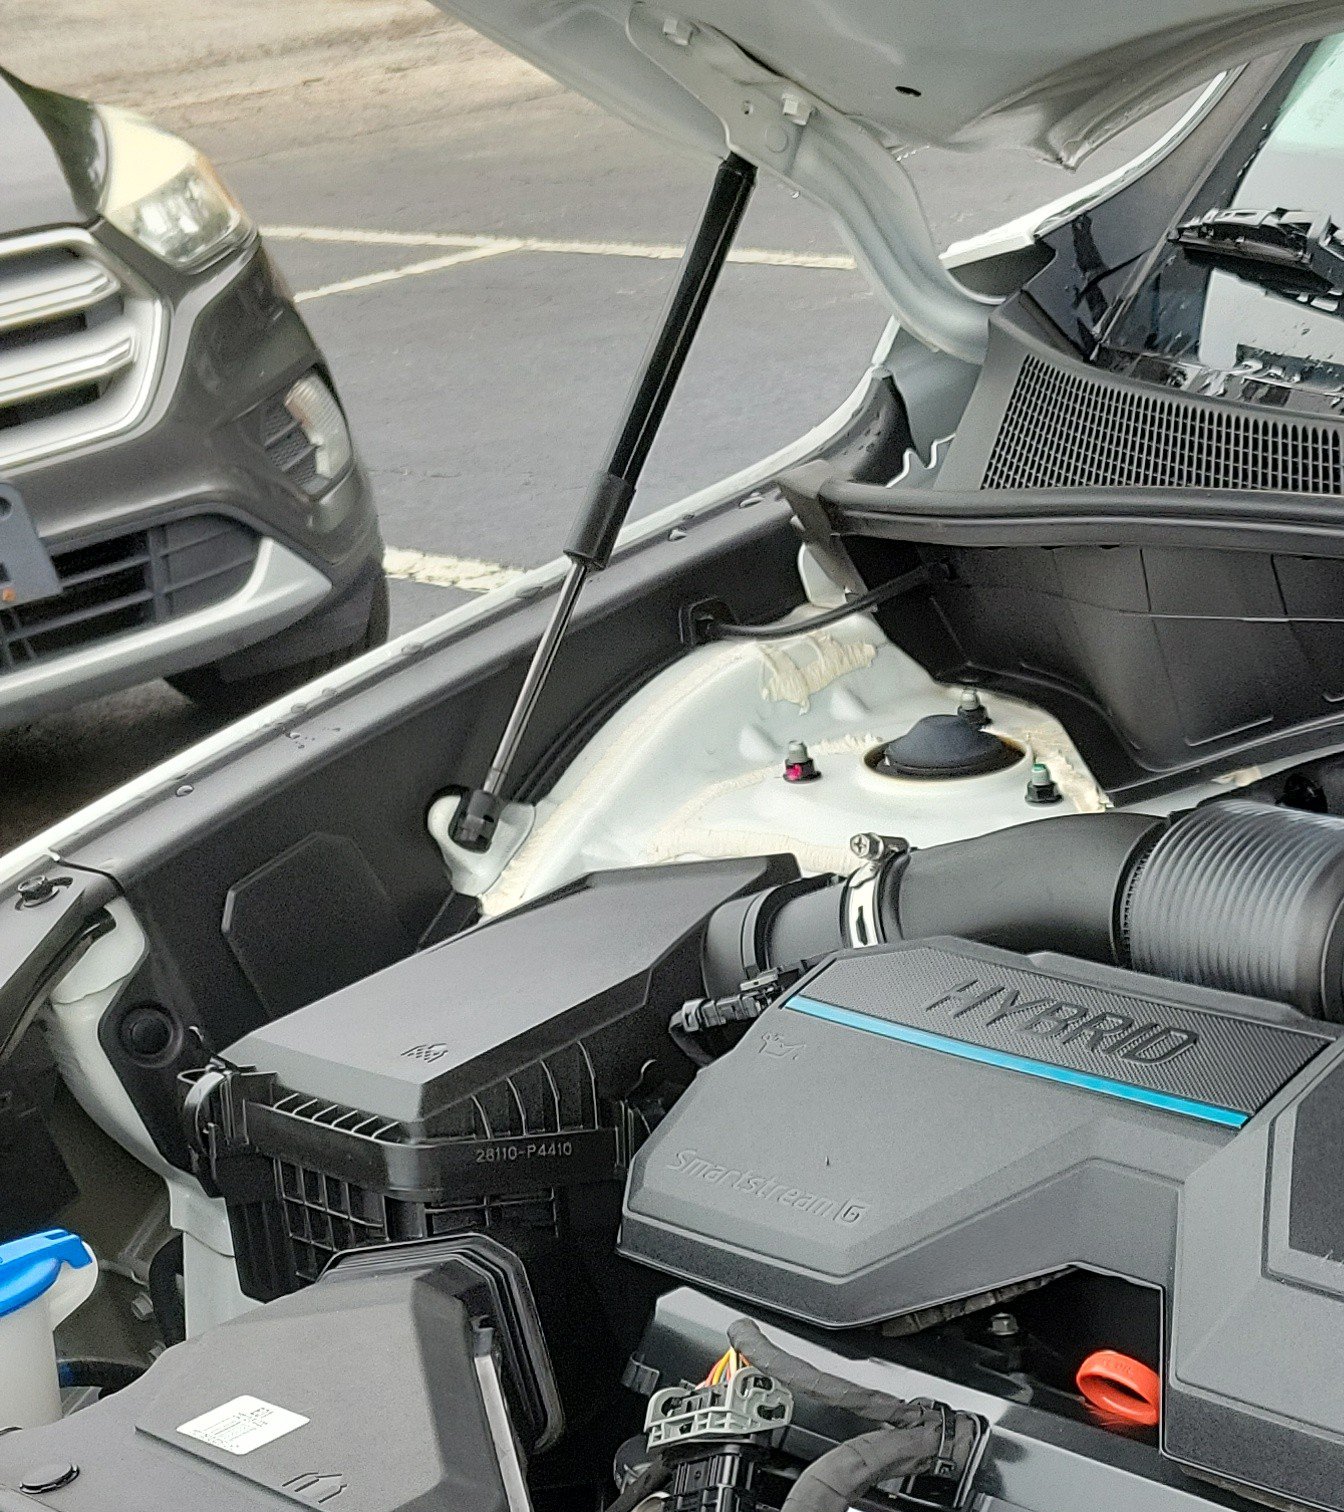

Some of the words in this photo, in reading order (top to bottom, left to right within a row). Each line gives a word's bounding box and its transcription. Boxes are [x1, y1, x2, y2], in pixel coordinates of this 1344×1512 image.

[926, 979, 1198, 1064] HYBRID
[476, 1141, 573, 1163] 28110-P4410
[666, 1149, 834, 1216] Smartstream
